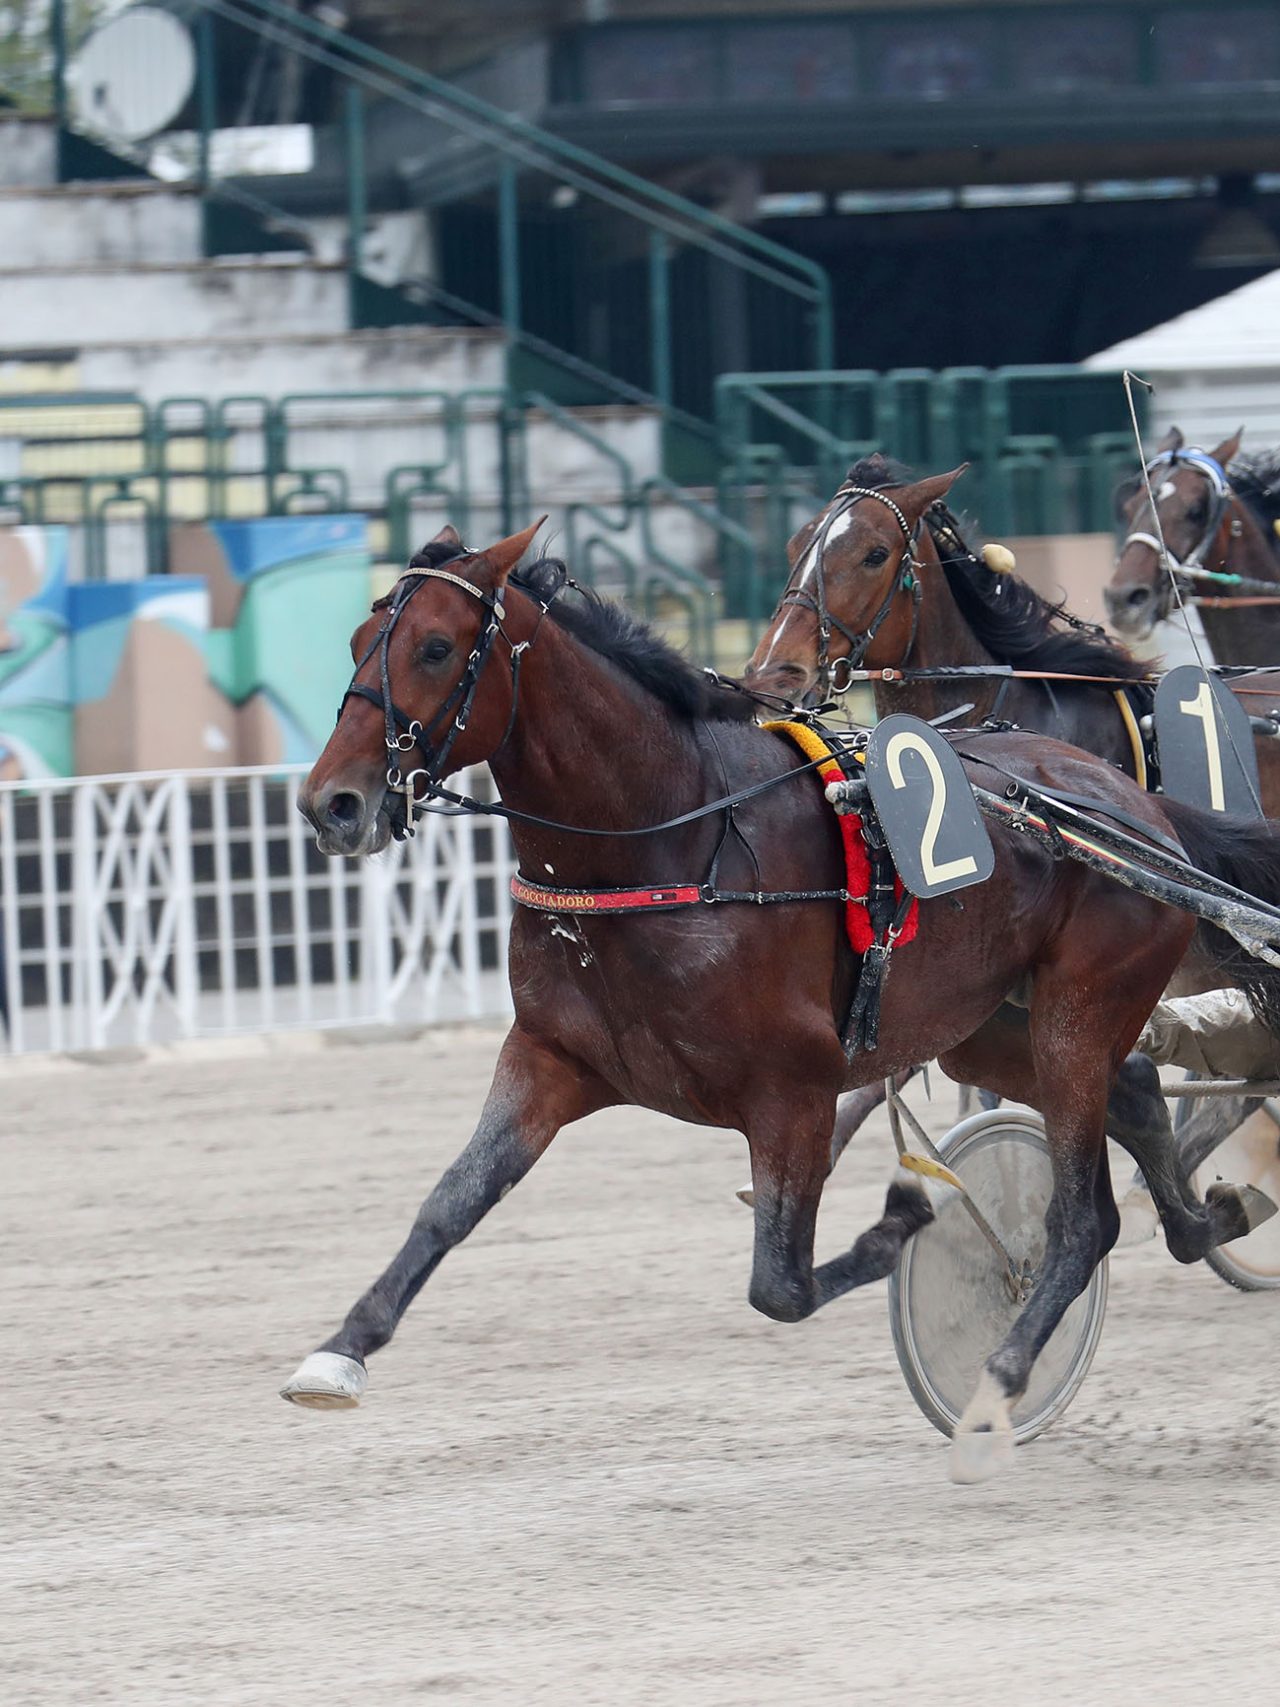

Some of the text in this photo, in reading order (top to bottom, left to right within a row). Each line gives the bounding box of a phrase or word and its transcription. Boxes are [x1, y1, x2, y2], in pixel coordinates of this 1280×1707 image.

[885, 731, 978, 887] 2
[1179, 682, 1226, 812] 1
[518, 887, 595, 908] GOCCIADORO
